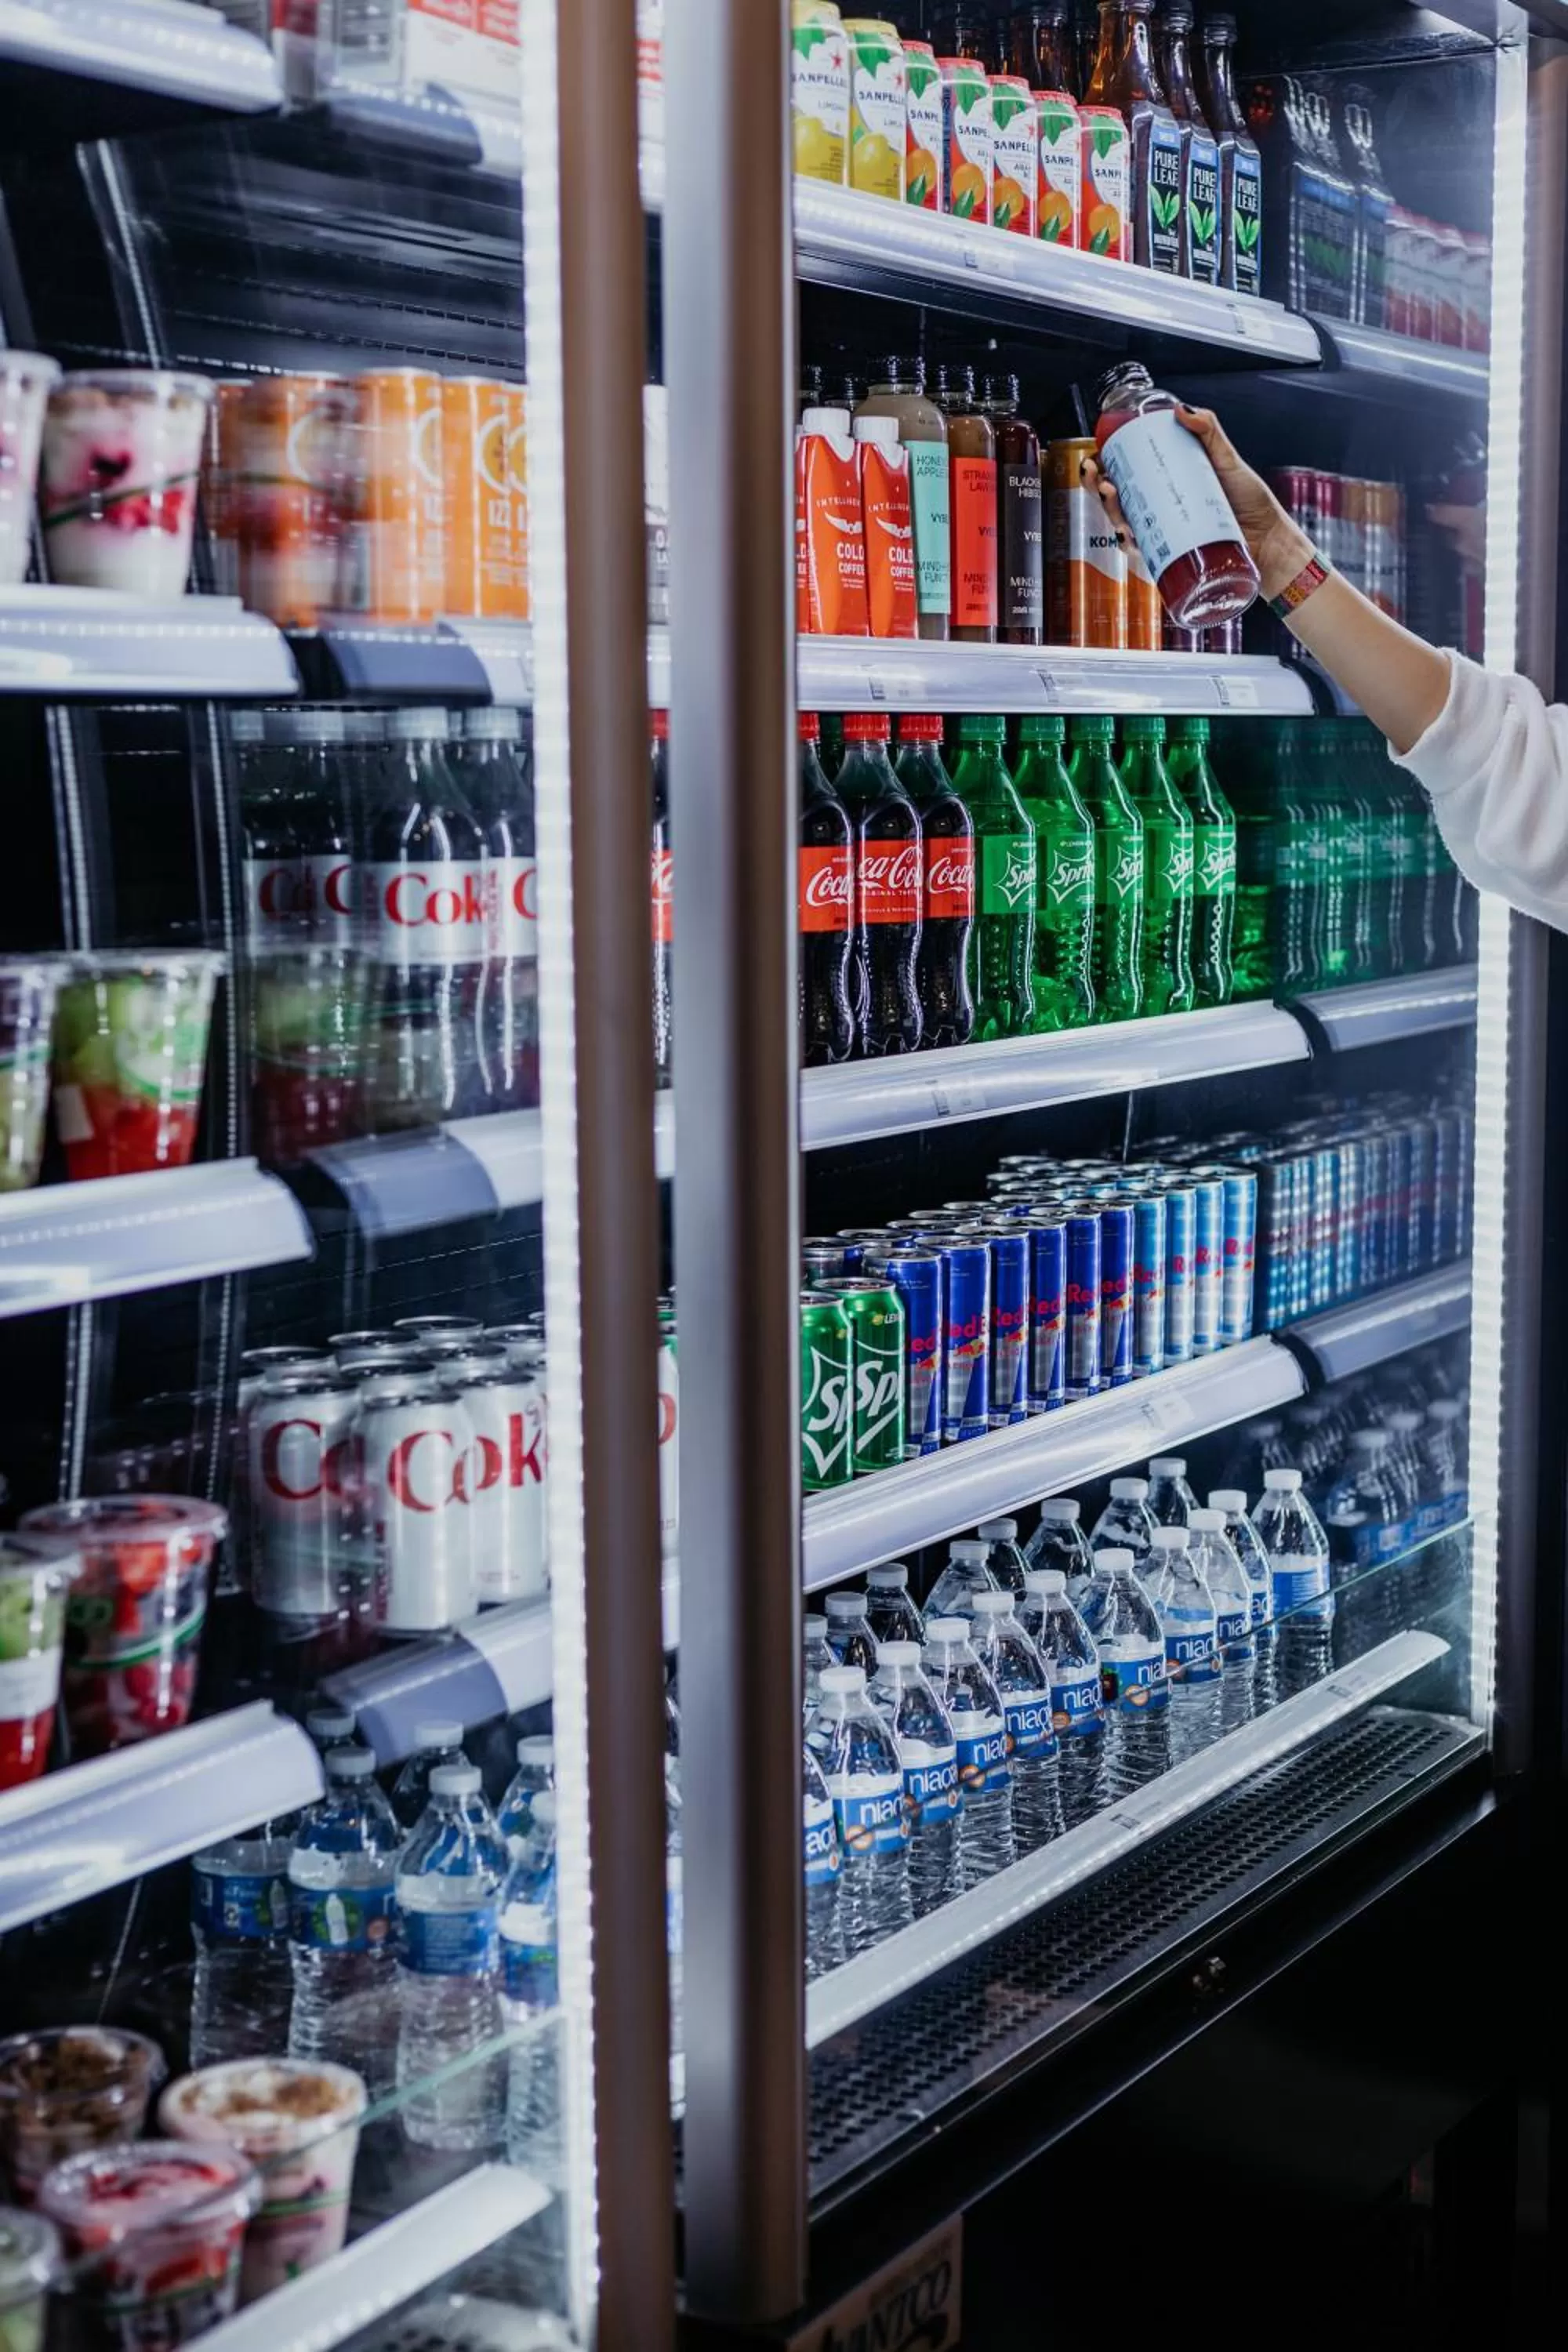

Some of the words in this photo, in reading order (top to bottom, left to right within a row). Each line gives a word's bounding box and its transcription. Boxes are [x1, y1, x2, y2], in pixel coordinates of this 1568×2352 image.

[1154, 150, 1178, 170] PURE
[1193, 167, 1217, 187] PURE
[1238, 178, 1258, 197] PURE
[837, 542, 865, 560] COLD
[889, 546, 913, 563] COLD
